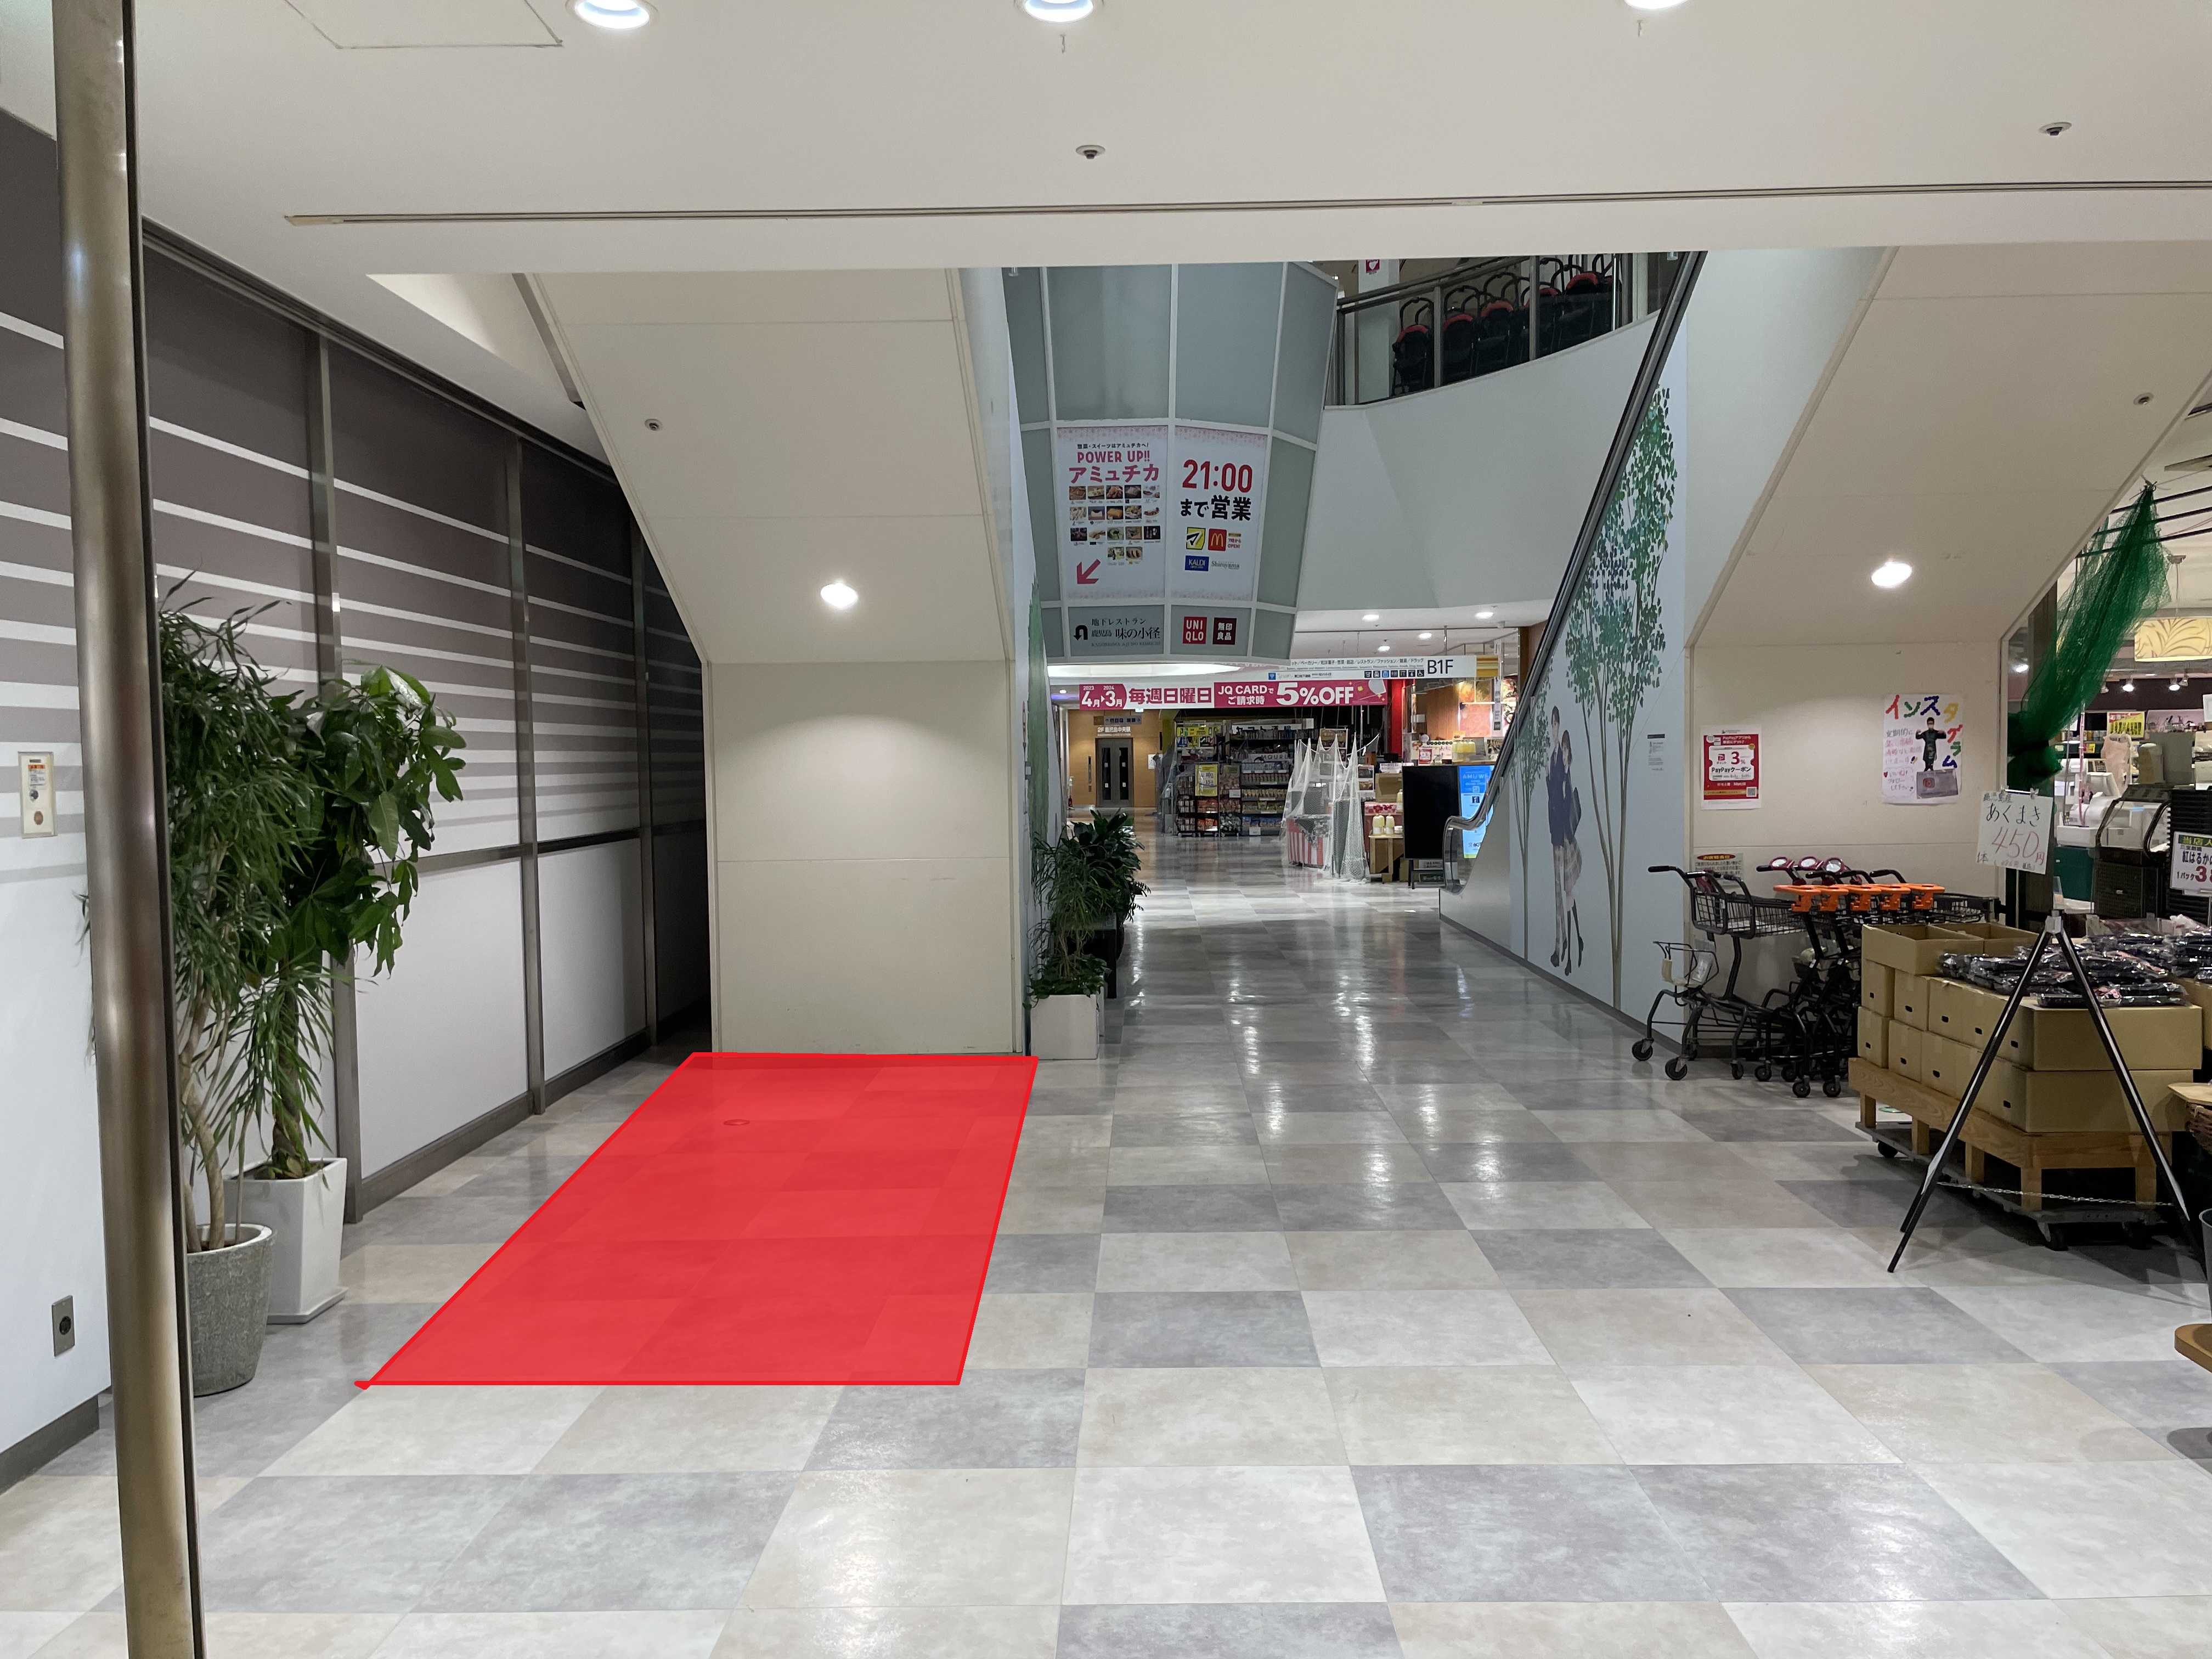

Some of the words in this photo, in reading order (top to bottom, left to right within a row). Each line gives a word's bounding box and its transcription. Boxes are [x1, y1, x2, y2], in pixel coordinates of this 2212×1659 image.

[1077, 451, 1122, 464] POWER
[1127, 450, 1150, 462] UP!!
[1069, 464, 1159, 483] アミュチカ
[1182, 459, 1252, 493] 21:00
[1181, 494, 1251, 521] まで営業
[1092, 618, 1146, 626] 地下レストラン
[1186, 620, 1203, 630] UNI
[1217, 622, 1232, 631] 無印
[1115, 627, 1160, 640] 味の小径
[1186, 631, 1204, 642] QLO
[1217, 631, 1232, 640] 良品
[1427, 659, 1453, 674] B1F
[1128, 687, 1212, 704] 毎週日曜日
[1218, 686, 1233, 695] JQ
[1276, 682, 1354, 706] 5%OFF
[1081, 691, 1100, 708] 4月
[1105, 690, 1122, 707] 3月
[1228, 695, 1266, 706] ご請求時
[1986, 803, 2041, 827] あくまき
[2195, 865, 2212, 883] 3
